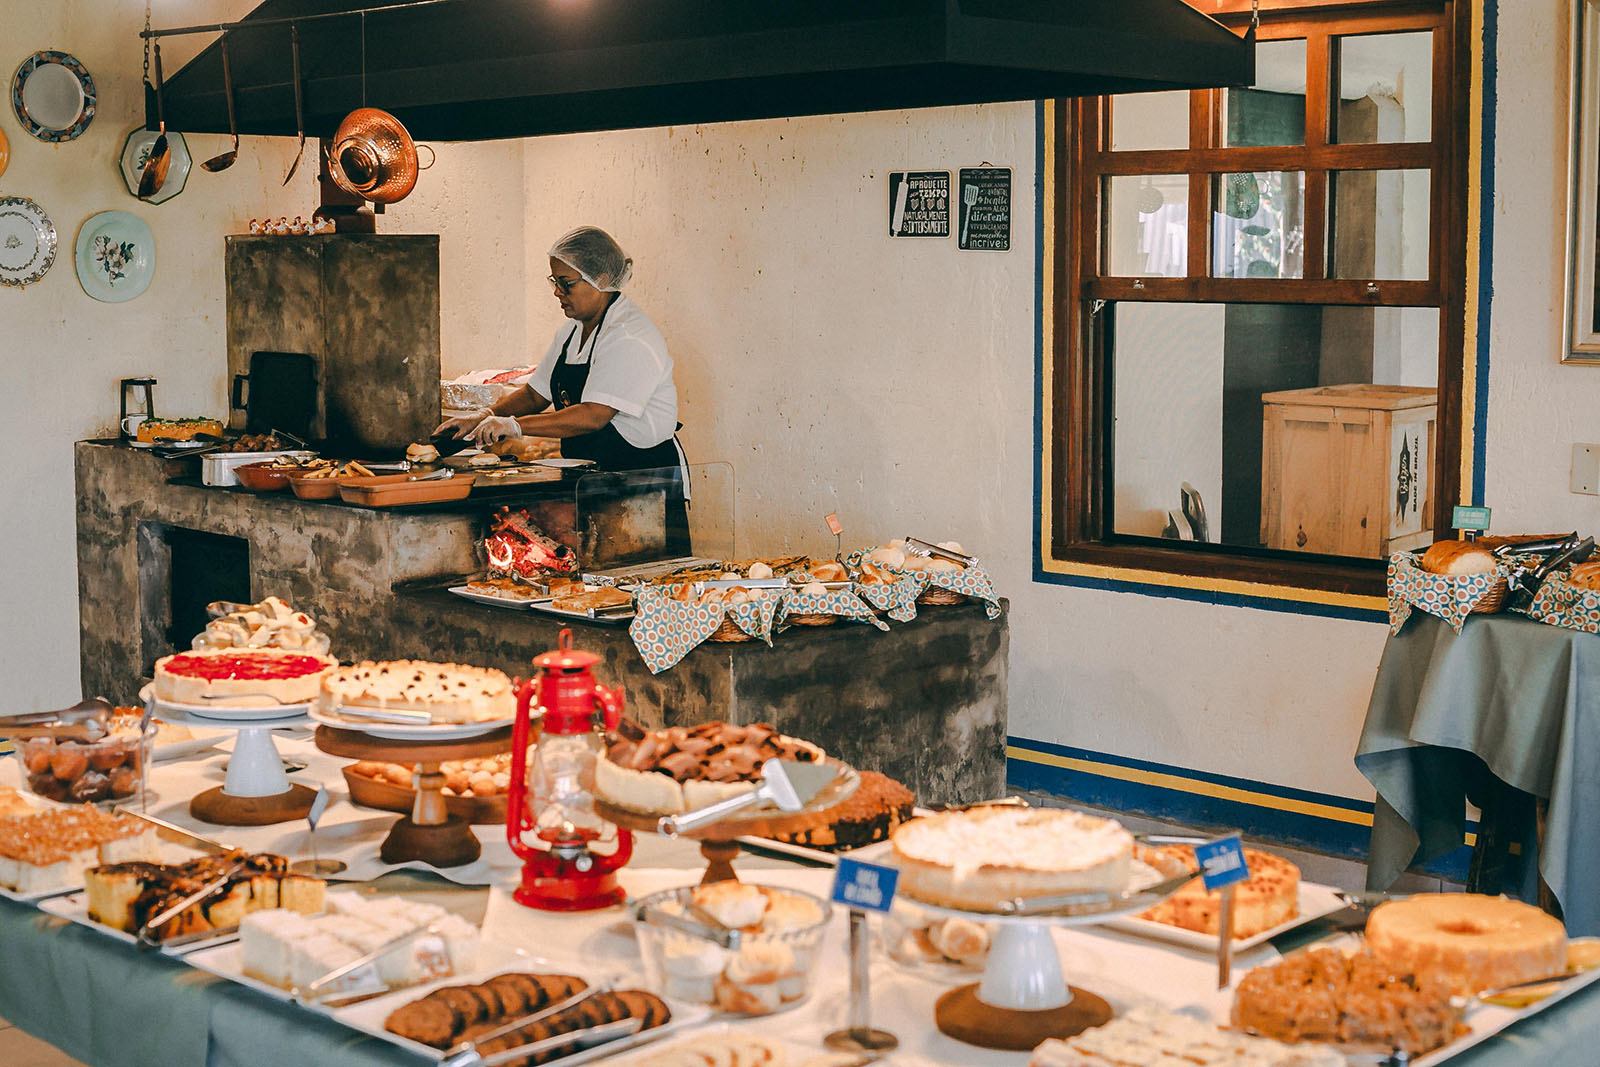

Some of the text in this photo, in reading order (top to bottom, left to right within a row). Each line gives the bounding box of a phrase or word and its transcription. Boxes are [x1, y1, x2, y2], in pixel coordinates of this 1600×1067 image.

[919, 189, 948, 198] TEMPO
[903, 211, 948, 221] NATURALMENTE
[1414, 472, 1418, 482] IN
